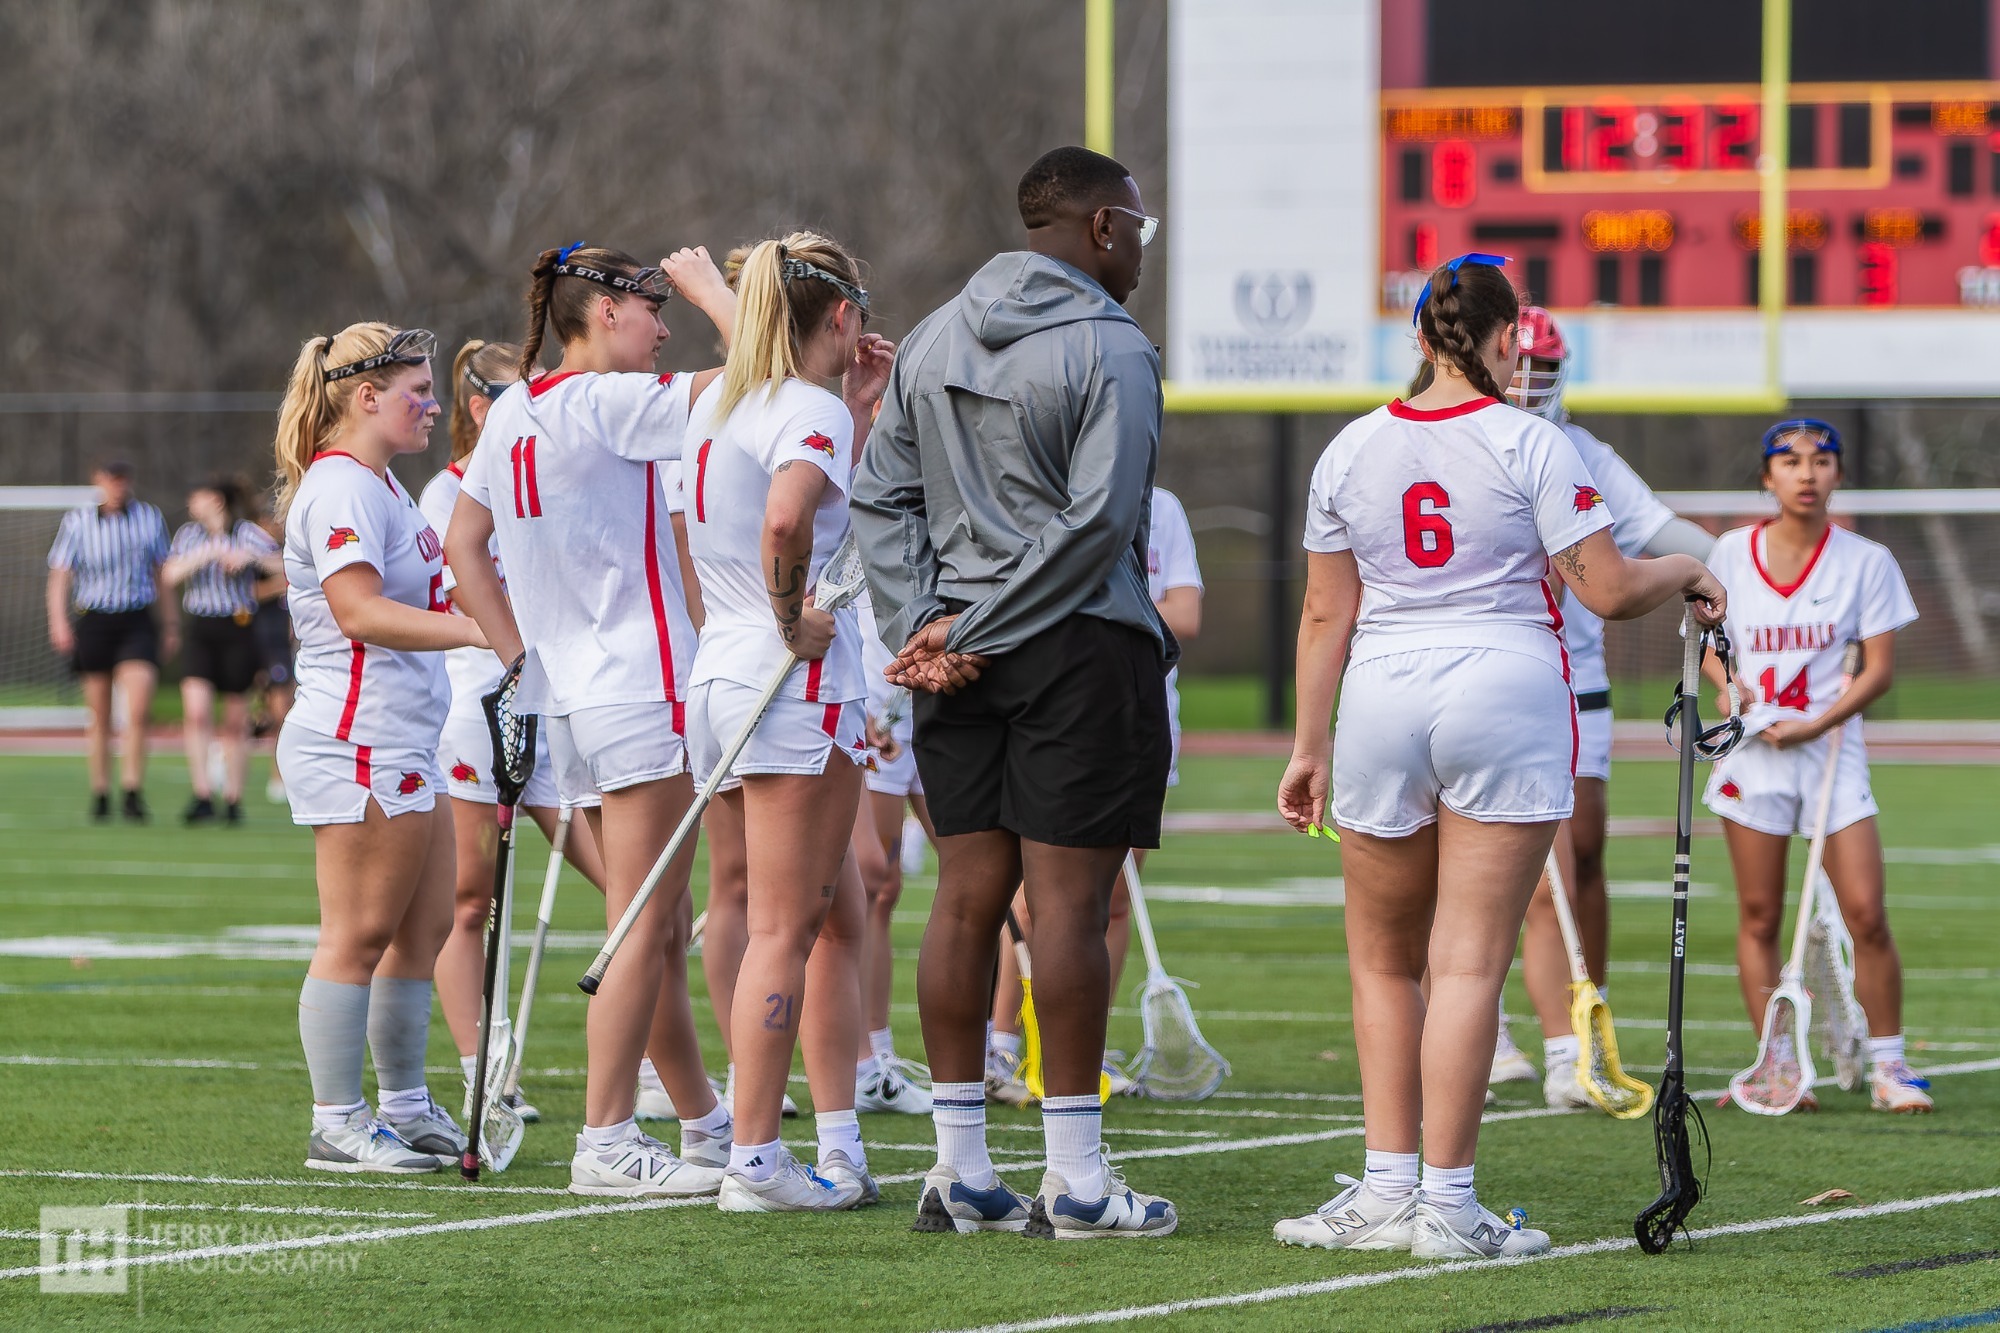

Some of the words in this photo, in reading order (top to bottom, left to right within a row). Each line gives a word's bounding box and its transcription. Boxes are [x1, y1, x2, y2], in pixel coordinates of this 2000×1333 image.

[575, 266, 607, 282] STX
[329, 364, 356, 380] STX
[363, 351, 394, 369] STX
[510, 434, 543, 519] 11
[696, 438, 713, 523] 1
[1401, 481, 1455, 569] 6
[1745, 623, 1837, 655] ARDINALS
[1759, 664, 1812, 713] 14
[1673, 917, 1686, 958] GAIT
[763, 992, 794, 1031] 21
